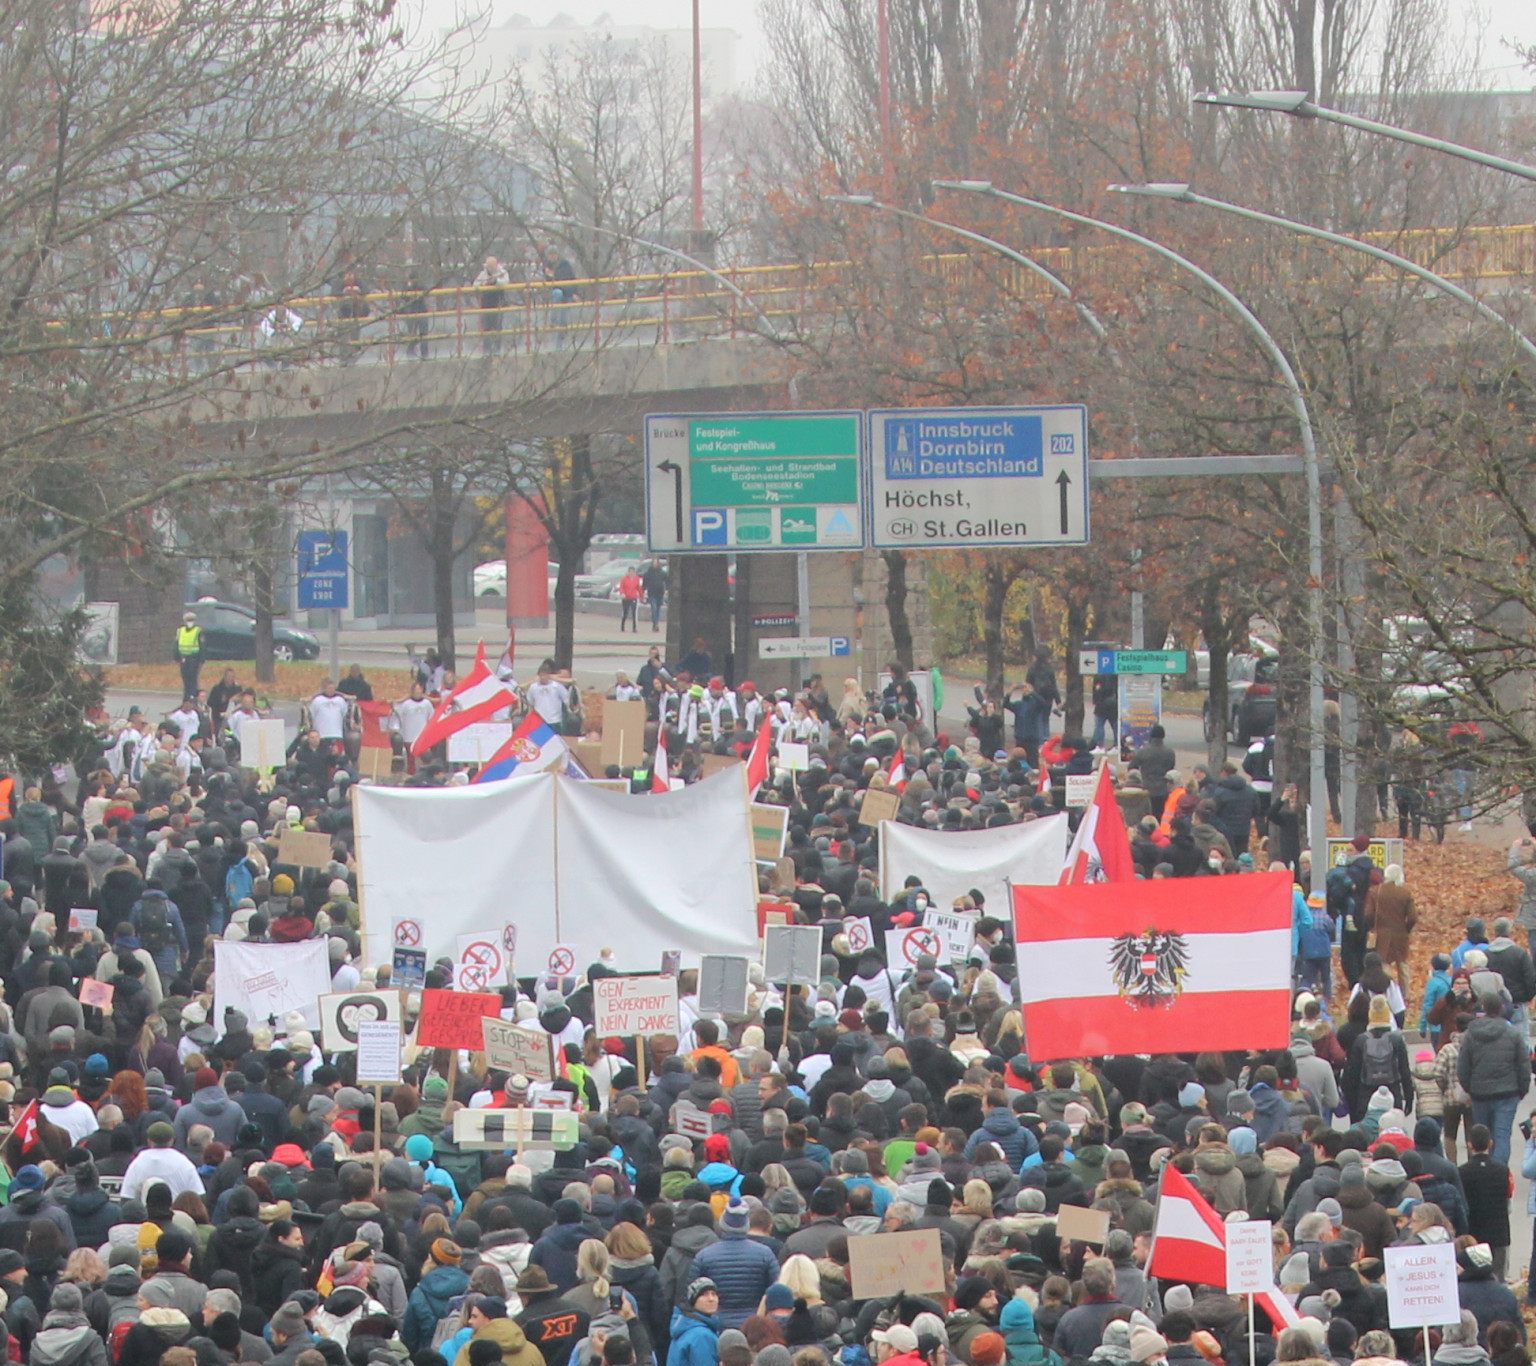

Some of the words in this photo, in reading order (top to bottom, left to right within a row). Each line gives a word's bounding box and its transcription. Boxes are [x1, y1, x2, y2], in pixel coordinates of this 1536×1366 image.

[654, 428, 685, 438] Brücke
[696, 427, 740, 439] Festspiel-
[919, 422, 1014, 438] Innsbruck
[696, 442, 714, 451] und
[716, 440, 776, 452] Kongreßhaus
[920, 440, 1005, 457] Dornbirn
[1052, 436, 1074, 453] 202
[766, 463, 783, 472] und
[788, 463, 837, 472] Strandbad
[892, 457, 913, 473] A14
[920, 458, 1038, 474] Deutschland
[885, 489, 971, 509] Höchst,
[695, 511, 724, 544] P
[891, 522, 913, 536] CH
[1117, 653, 1169, 662] Festspielhaus
[600, 1014, 628, 1031] NEIN
[637, 1014, 676, 1031] DANKE
[489, 1027, 525, 1050] STOP
[1404, 1256, 1437, 1267] ALLEIN
[1407, 1271, 1437, 1281] JESUS
[1403, 1296, 1444, 1306] RETTEN!
[541, 1314, 578, 1341] XT
